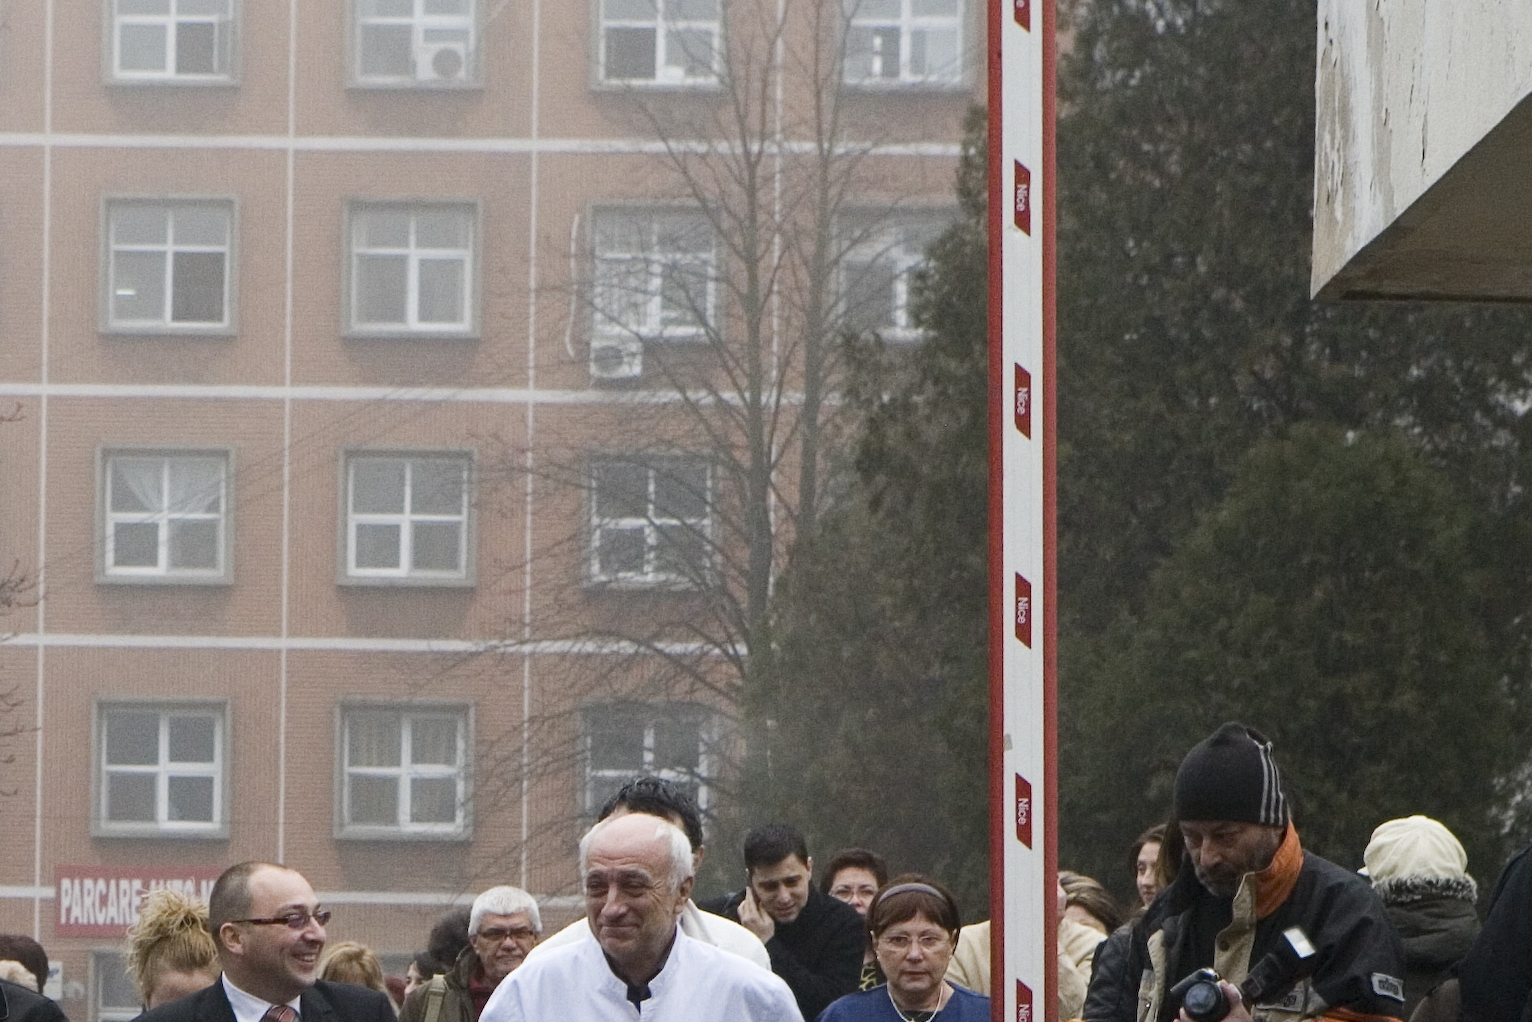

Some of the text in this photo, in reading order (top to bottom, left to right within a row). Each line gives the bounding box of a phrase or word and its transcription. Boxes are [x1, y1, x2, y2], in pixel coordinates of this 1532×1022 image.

[1017, 184, 1028, 211] Nice
[1017, 387, 1028, 414] Nice
[1018, 596, 1029, 624] Nice
[1018, 798, 1029, 825] Nice
[60, 878, 142, 925] PARCARE
